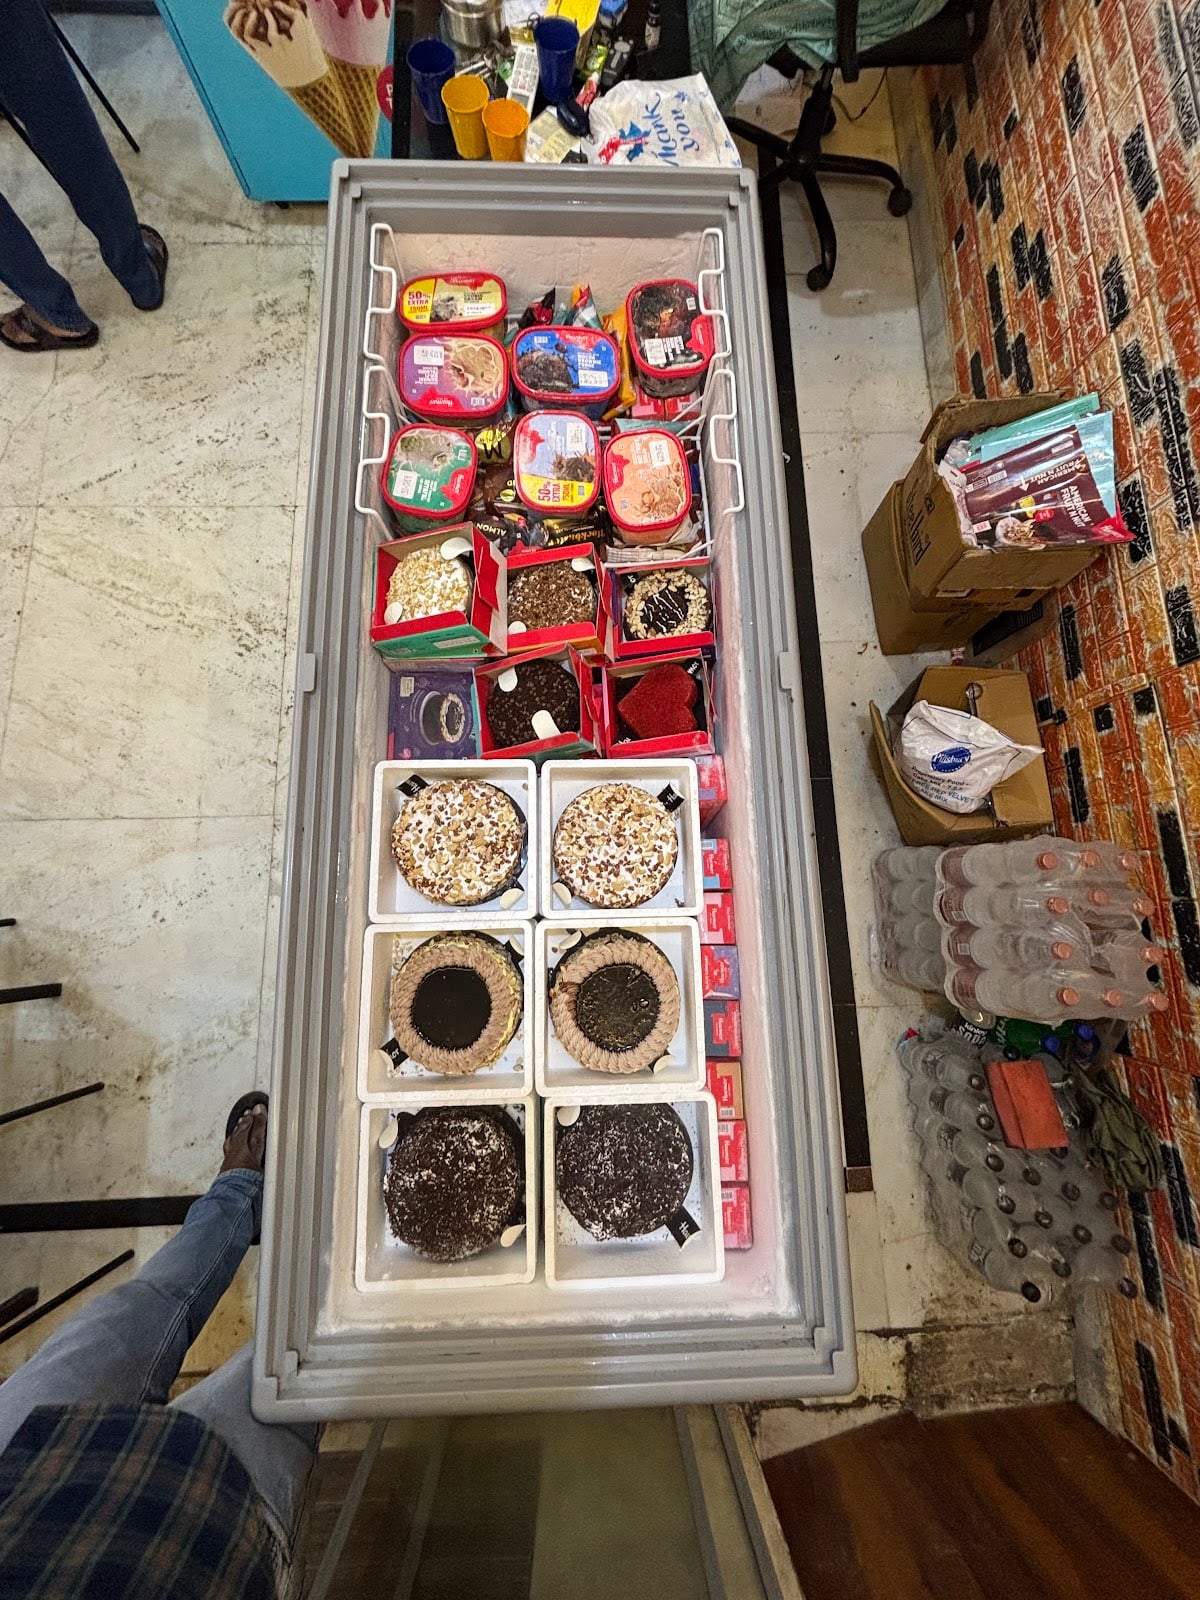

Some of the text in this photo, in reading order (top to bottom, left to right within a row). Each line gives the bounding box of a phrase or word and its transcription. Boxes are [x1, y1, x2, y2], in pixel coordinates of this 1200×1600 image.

[671, 109, 700, 151] you
[552, 483, 561, 503] EXTRA
[1060, 487, 1074, 511] FRUIT
[1071, 516, 1086, 528] NUT
[1068, 485, 1092, 523] AMERICAN
[476, 523, 507, 536] ALMON
